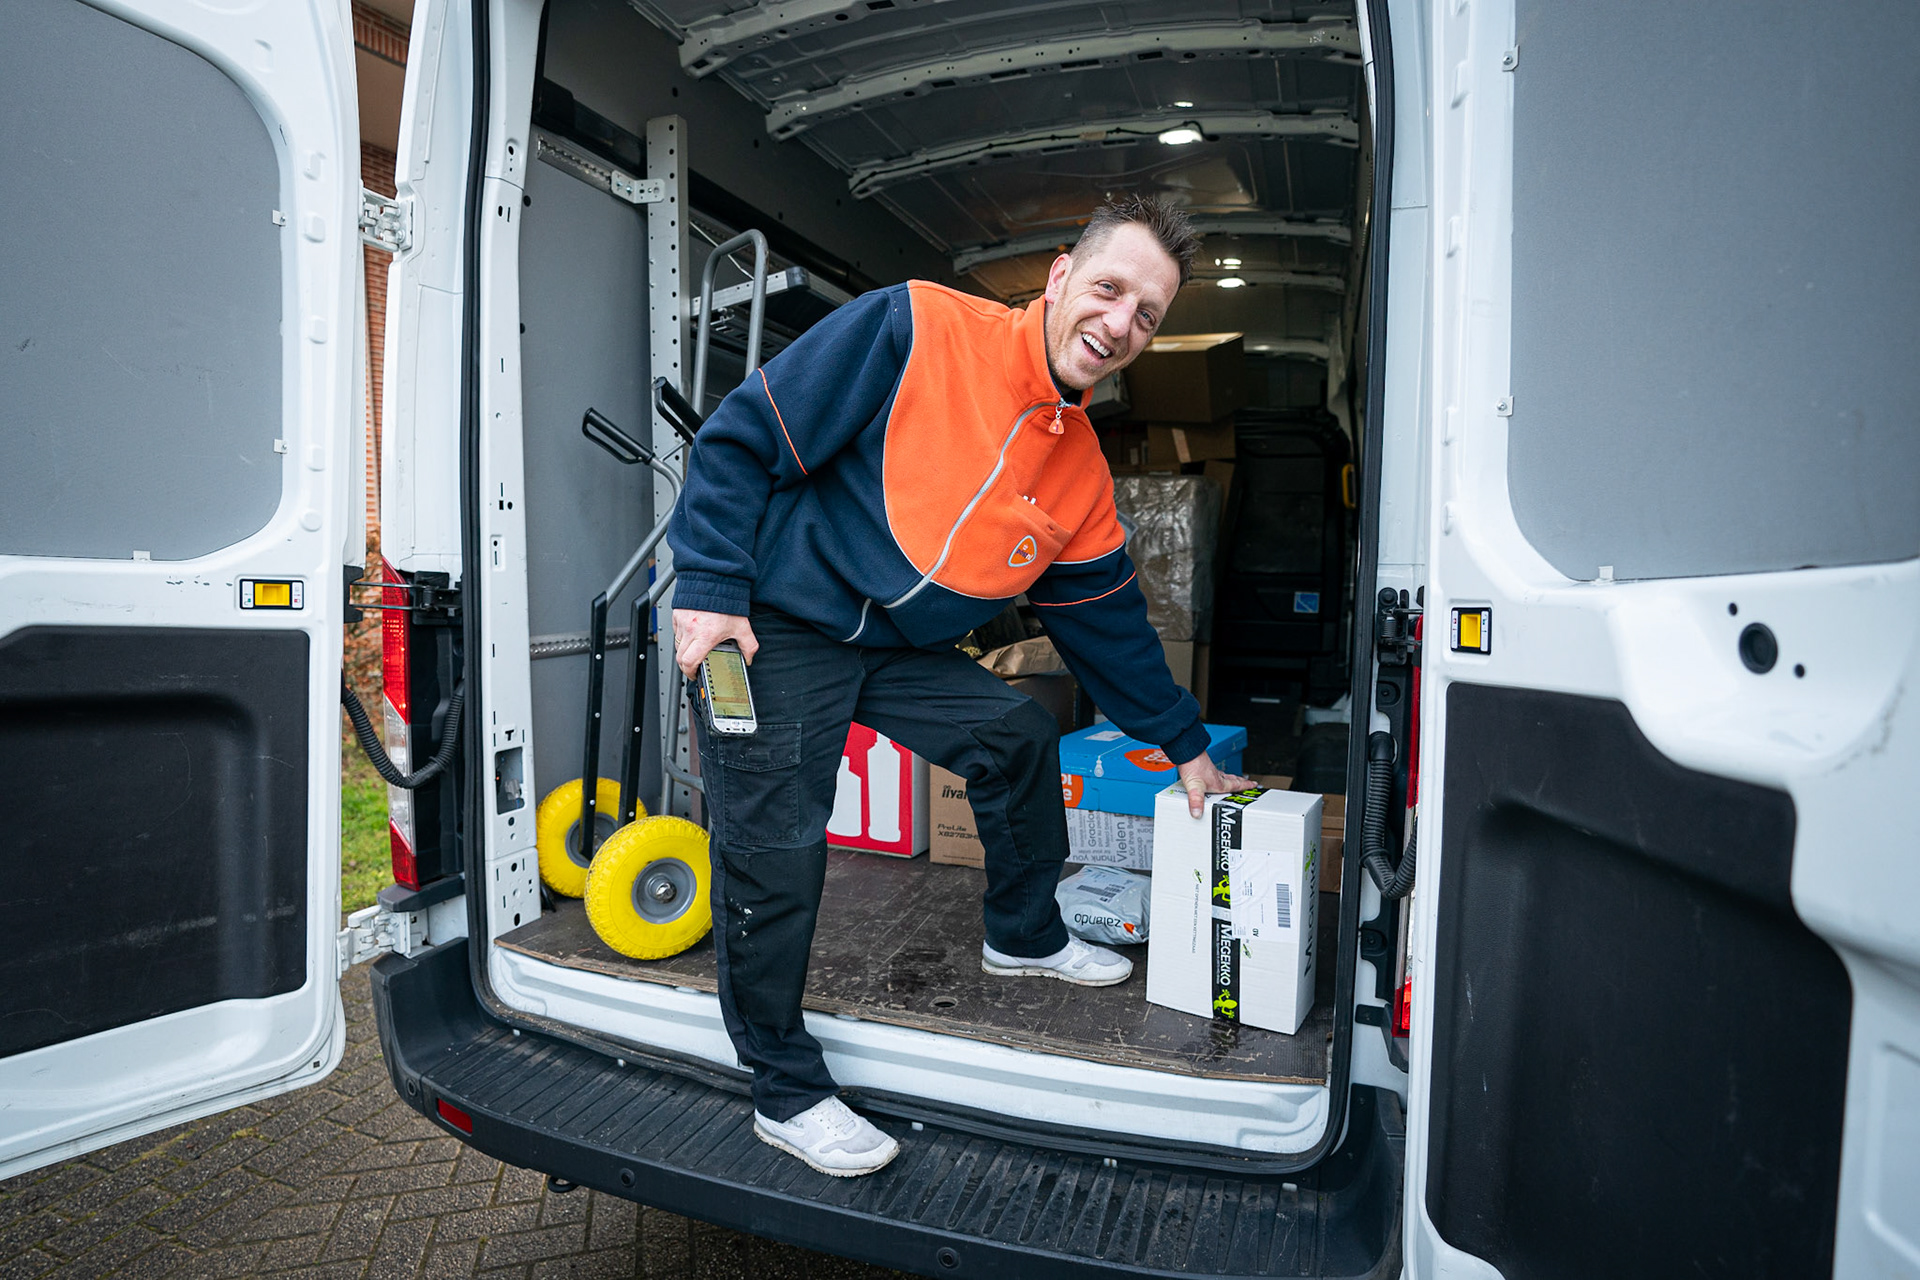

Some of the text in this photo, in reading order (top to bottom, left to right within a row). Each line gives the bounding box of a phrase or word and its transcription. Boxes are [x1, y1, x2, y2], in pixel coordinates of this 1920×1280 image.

[1087, 813, 1097, 847] Gracia
[1115, 821, 1127, 863] Vielen
[1091, 855, 1116, 863] Thank
[1074, 913, 1121, 928] zalando
[1220, 923, 1233, 986] MEGEKKO
